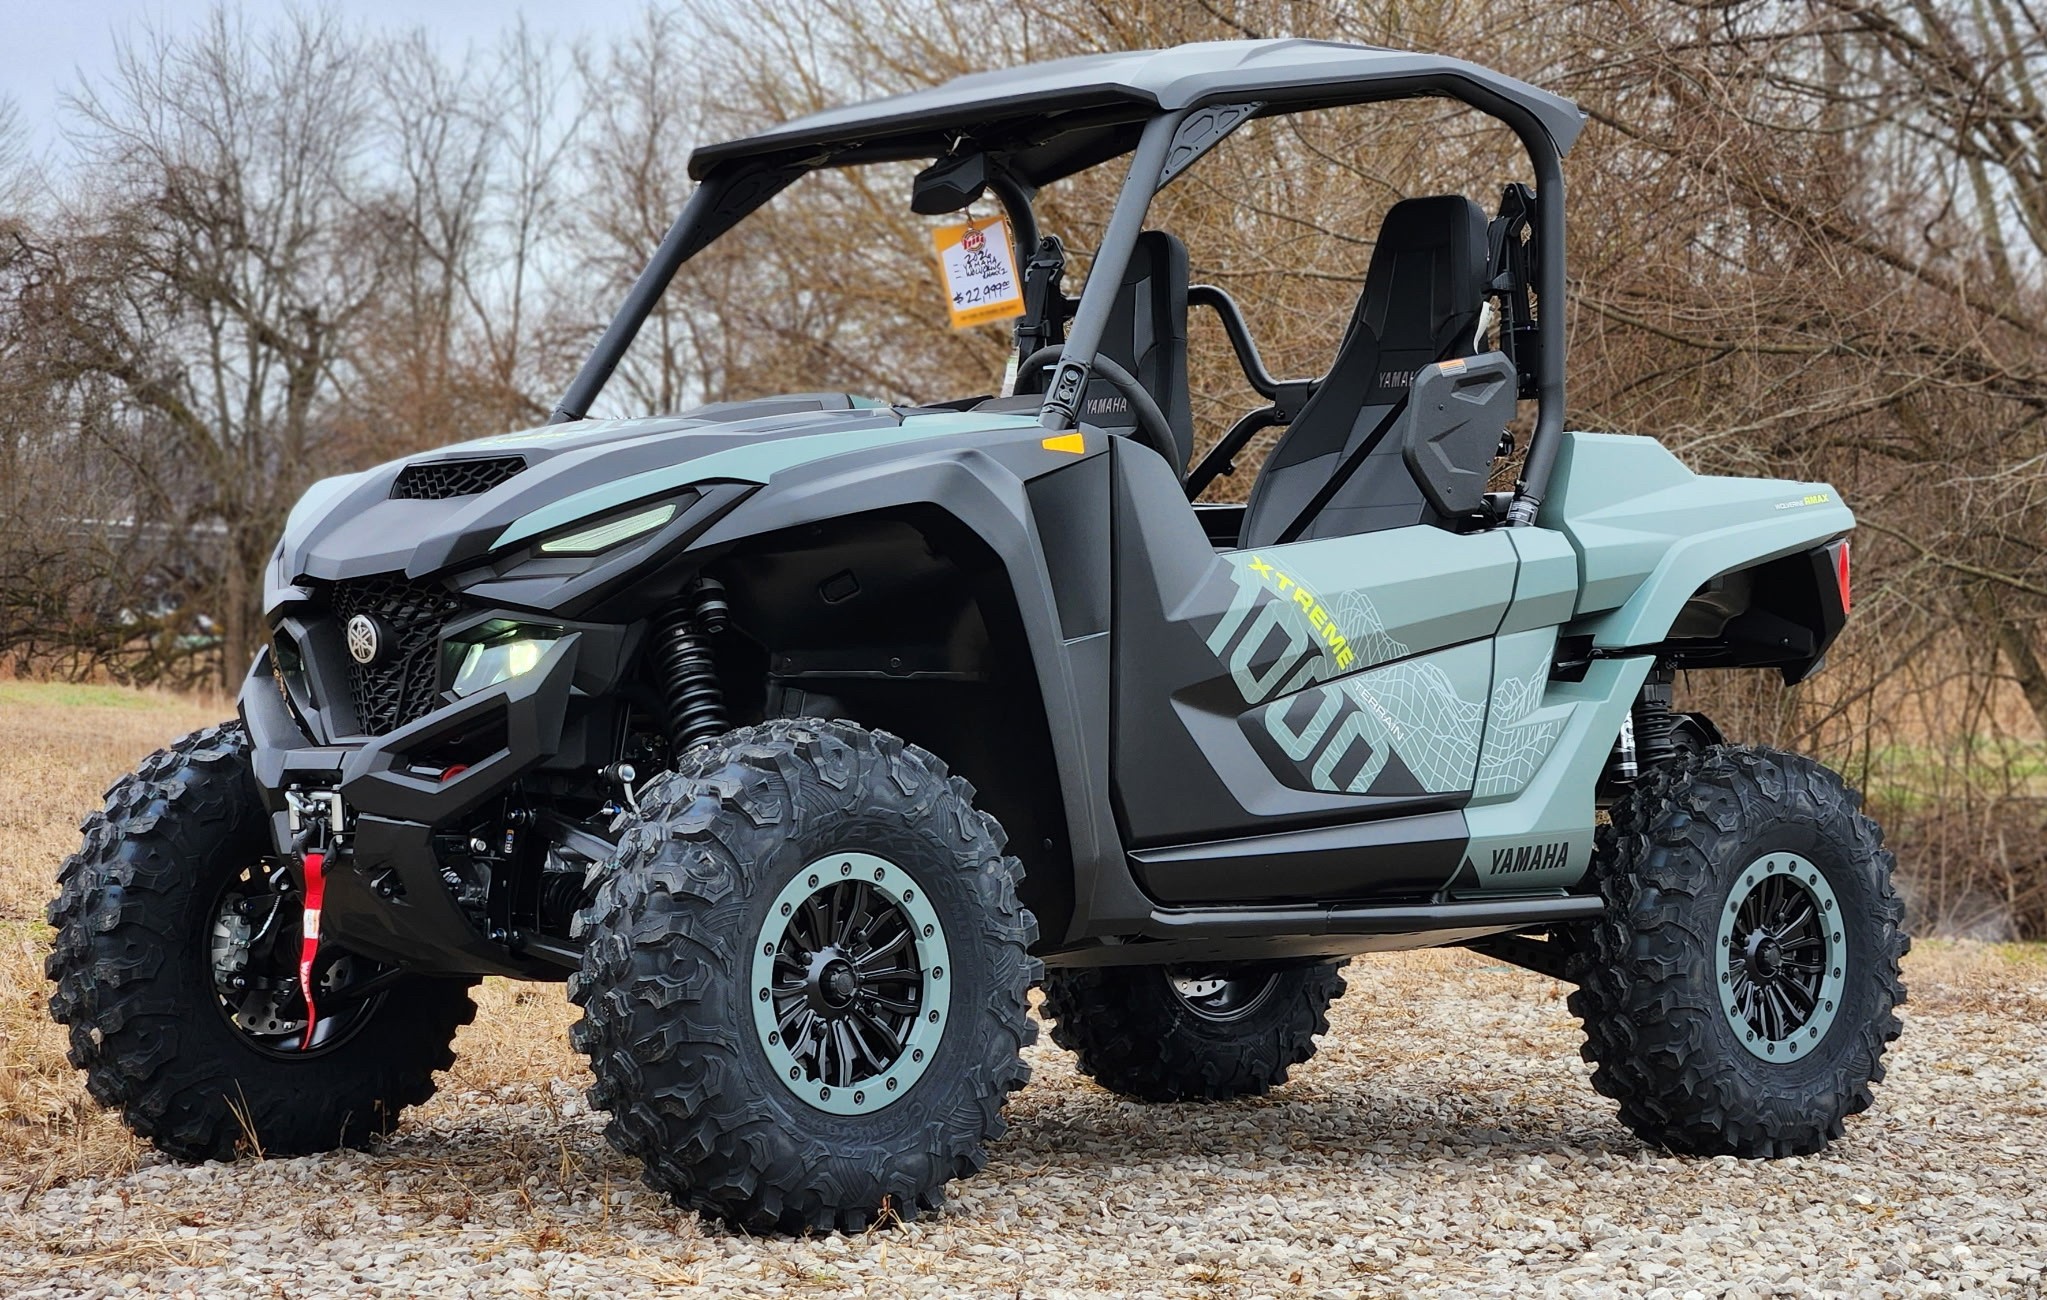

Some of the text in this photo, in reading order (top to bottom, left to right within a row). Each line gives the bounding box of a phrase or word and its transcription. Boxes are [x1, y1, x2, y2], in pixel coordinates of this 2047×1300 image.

[1086, 397, 1127, 415] YAMAHA
[1248, 555, 1355, 670] XTREME
[1355, 680, 1405, 742] TERRAIN
[1490, 842, 1569, 875] YAMAHA
